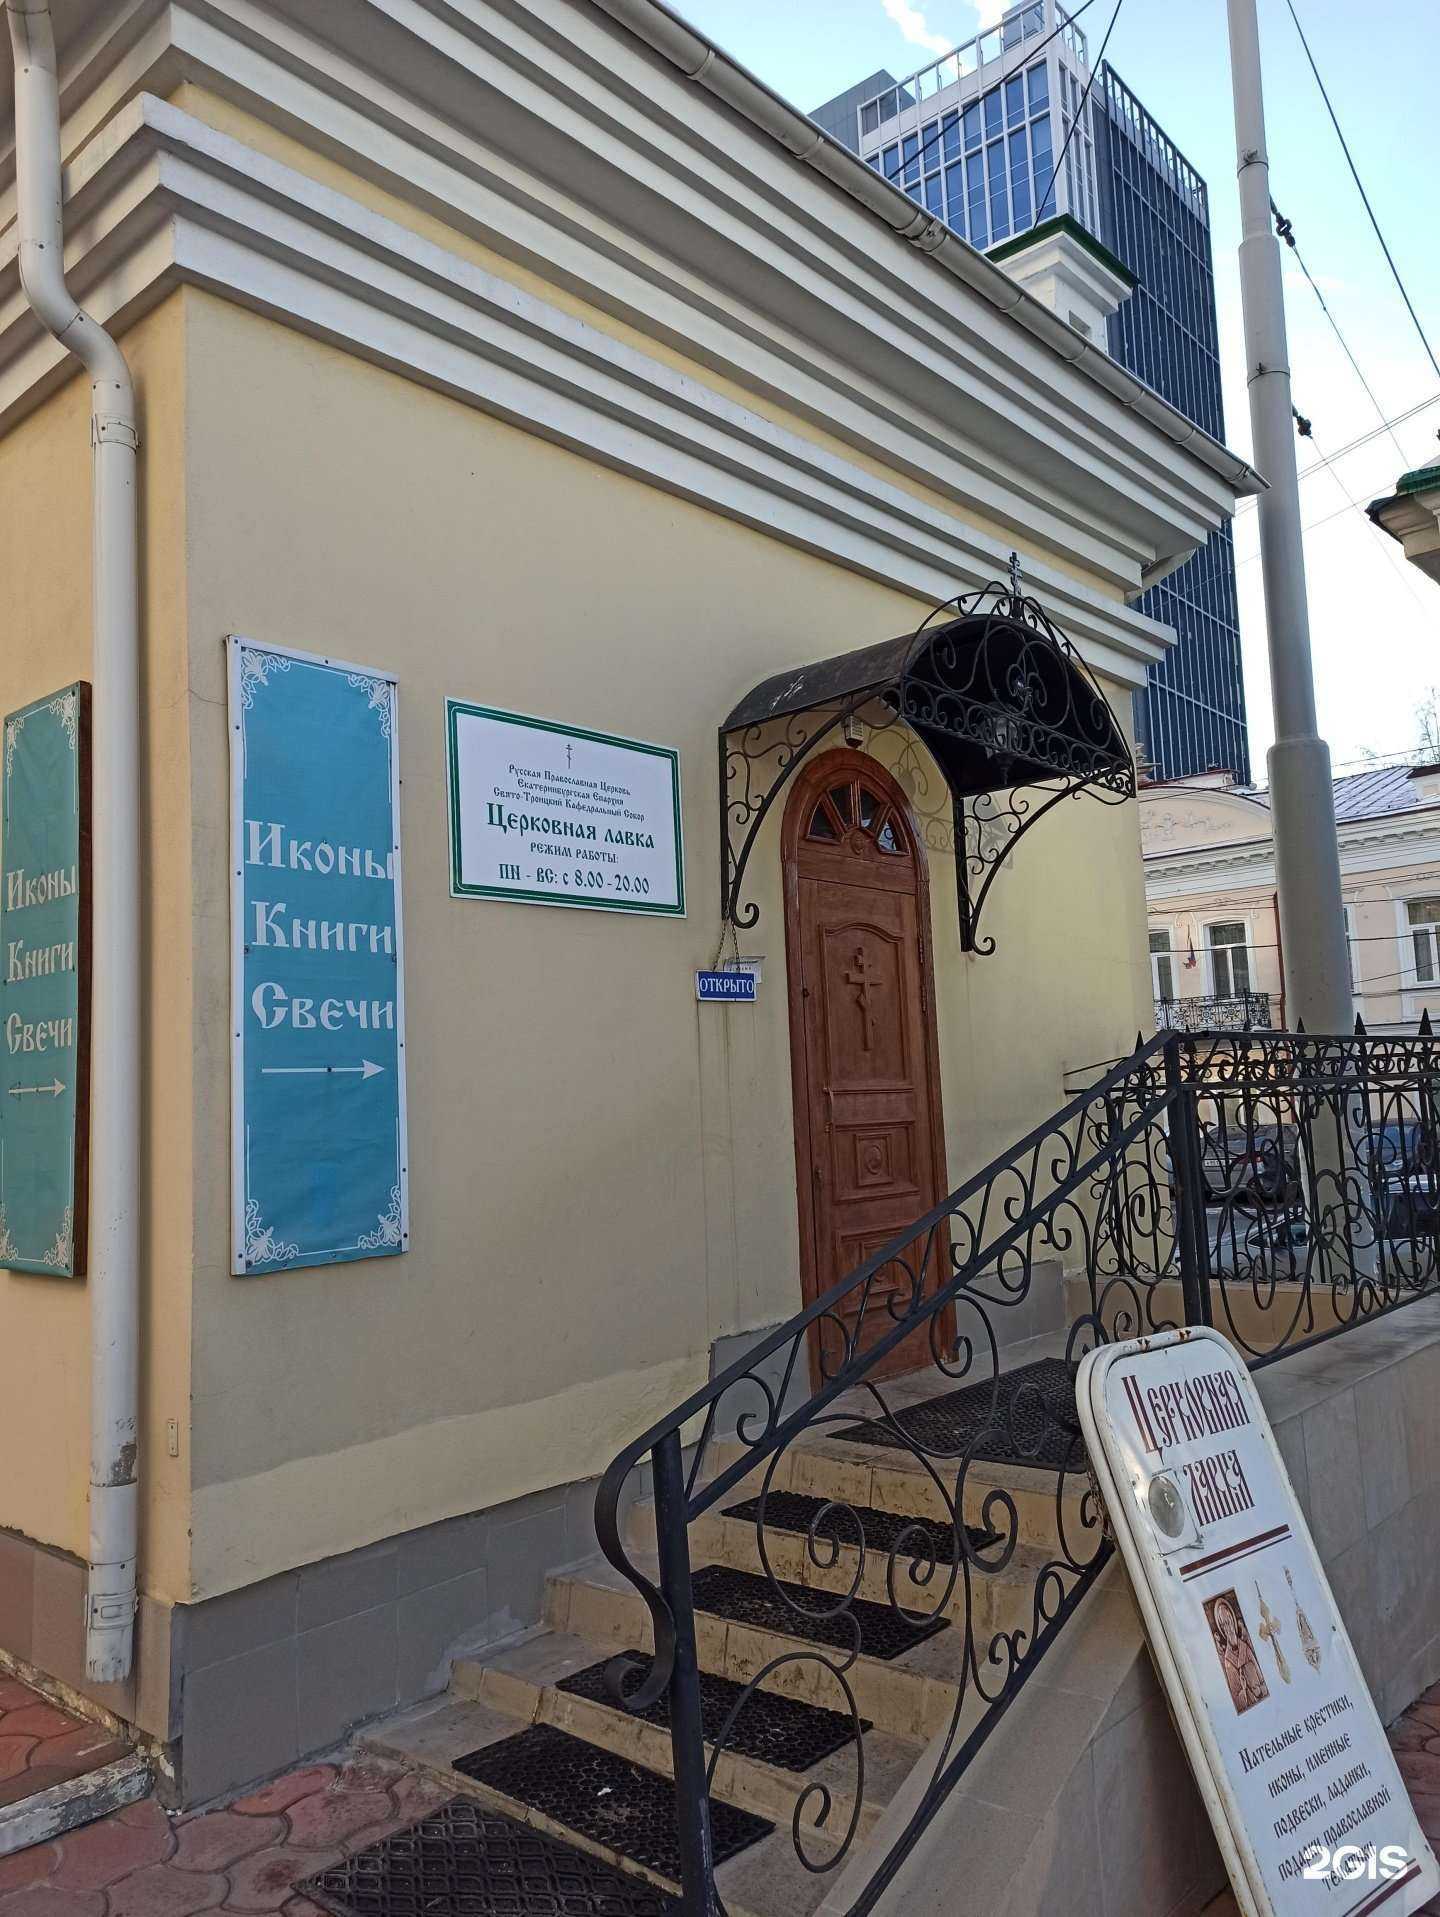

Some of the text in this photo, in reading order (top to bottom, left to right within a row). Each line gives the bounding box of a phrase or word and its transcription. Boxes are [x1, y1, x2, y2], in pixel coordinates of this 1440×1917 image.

[509, 764, 631, 795] Русская Православная Церковь
[518, 779, 590, 799] Екатеринбургская
[486, 802, 655, 848] Церковная лавка
[565, 799, 622, 816] Кафедральный
[624, 809, 645, 823] Собор
[245, 819, 394, 880] Иконы
[7, 864, 76, 912] Иконы
[498, 864, 521, 880] ПН
[537, 867, 558, 884] ВС:
[250, 901, 392, 954] Книги
[7, 939, 74, 982] Книги
[252, 982, 394, 1030] Свечи
[700, 978, 754, 993] ОТКРЫТО
[6, 1012, 73, 1054] Свечи
[1239, 1694, 1354, 1773] Нательные крестики,
[1268, 1733, 1352, 1798] иконы, именные
[1273, 1762, 1372, 1839] подвески, ладанки,
[1278, 1784, 1391, 1881] подарки православной
